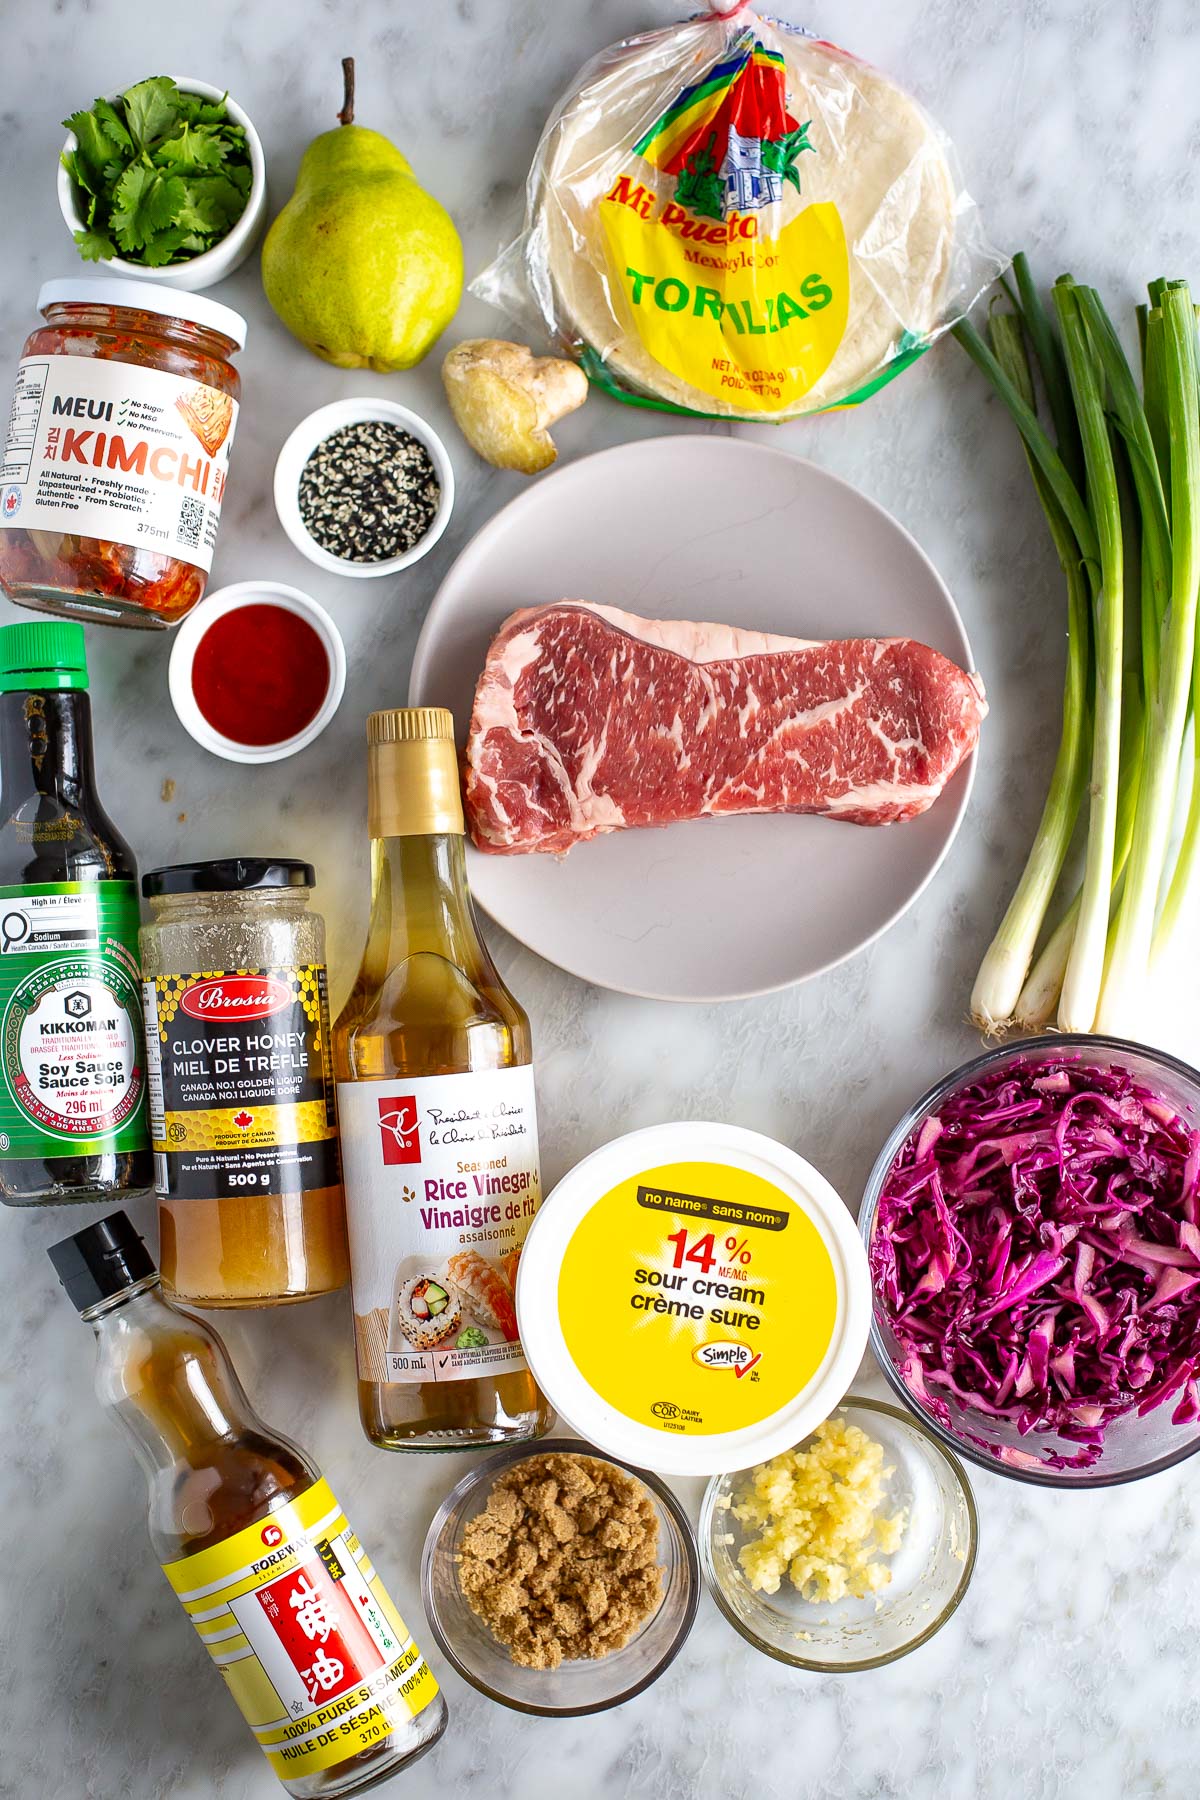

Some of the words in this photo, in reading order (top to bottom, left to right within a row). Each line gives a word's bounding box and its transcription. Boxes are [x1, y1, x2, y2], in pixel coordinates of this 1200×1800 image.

[607, 176, 657, 220] Mi
[711, 358, 731, 372] NET
[52, 396, 114, 422] MEUI
[130, 400, 142, 408] No
[142, 403, 165, 414] Sugar
[126, 421, 138, 429] No
[140, 413, 158, 422] MSG
[61, 428, 211, 495] KIMCHI
[40, 470, 50, 478] All
[50, 472, 82, 482] Natural
[91, 477, 124, 491] Freshly
[124, 484, 150, 496] made
[38, 479, 97, 494] Unpasteurized
[103, 489, 146, 505] Probiotics
[35, 498, 60, 508] Gluten
[60, 500, 80, 510] Free
[36, 489, 75, 500] Authentic
[84, 495, 108, 506] From
[109, 500, 143, 513] Scratch
[137, 523, 169, 540] 375ml
[31, 898, 48, 907] High
[49, 897, 57, 905] in
[33, 932, 61, 942] Sodium
[11, 944, 28, 952] Health
[28, 943, 49, 951] Canada
[53, 941, 69, 949] Santé
[198, 986, 276, 1010] Brosia
[40, 1019, 117, 1035] KIKKOMAN
[172, 1036, 241, 1056] CLOVER
[246, 1031, 307, 1051] HONEY
[58, 1053, 74, 1062] Less
[173, 1060, 210, 1077] MIEL
[214, 1058, 240, 1074] DE
[244, 1051, 309, 1072] TRÈFLE
[39, 1063, 69, 1077] Soy
[75, 1061, 123, 1073] Sauce
[39, 1077, 89, 1089] Sauce
[94, 1072, 125, 1086] Soja
[180, 1082, 214, 1092] CANADA
[216, 1080, 235, 1090] NO.1
[237, 1078, 275, 1089] GOLDEN
[276, 1075, 303, 1086] LIQUID
[56, 1088, 78, 1098] Moins
[79, 1088, 89, 1096] de
[182, 1091, 217, 1102] CANADA
[219, 1090, 238, 1100] NO.1
[240, 1088, 276, 1099] LIQUIDE
[278, 1084, 301, 1095] DORÉ
[17, 1087, 35, 1111] PLUS
[36, 1110, 49, 1121] DE
[50, 1119, 69, 1129] 300
[71, 1124, 93, 1132] ANS
[22, 1085, 40, 1107] OVER
[40, 1105, 55, 1118] 300
[57, 1116, 88, 1126] YEARS
[65, 1100, 87, 1114] 296
[89, 1099, 103, 1112] ml
[429, 1130, 440, 1145] le
[442, 1128, 475, 1144] Choix
[216, 1154, 240, 1162] Natural
[242, 1160, 266, 1169] Agents
[456, 1156, 507, 1173] Seasoned
[228, 1173, 258, 1186] 500
[260, 1173, 271, 1186] g
[424, 1179, 467, 1201] Rice
[473, 1171, 531, 1196] Vinegar
[420, 1203, 500, 1230] Vinaigre
[505, 1201, 520, 1220] de
[522, 1195, 536, 1218] riz
[644, 1192, 662, 1205] no
[665, 1193, 702, 1212] name
[712, 1204, 743, 1220] sans
[745, 1210, 775, 1225] nom
[459, 1224, 516, 1243] assaisonné
[667, 1228, 717, 1274] 14
[725, 1236, 752, 1265] %
[634, 1267, 688, 1292] sour
[692, 1278, 765, 1306] cream
[630, 1292, 705, 1320] crème
[709, 1308, 761, 1330] sure
[392, 1357, 409, 1370] 500
[411, 1356, 426, 1370] mL
[702, 1346, 748, 1364] Simple
[680, 1414, 703, 1423] LAITIER
[681, 1408, 700, 1417] DAIRY
[283, 1718, 317, 1740] 100%
[316, 1695, 359, 1726] PURE
[358, 1664, 406, 1702] SESAME
[404, 1650, 418, 1670] OIL
[280, 1739, 317, 1761] HUILE
[317, 1728, 339, 1747] DE
[339, 1693, 396, 1735] SÉSAME
[397, 1673, 421, 1698] 100%
[359, 1725, 380, 1744] 370
